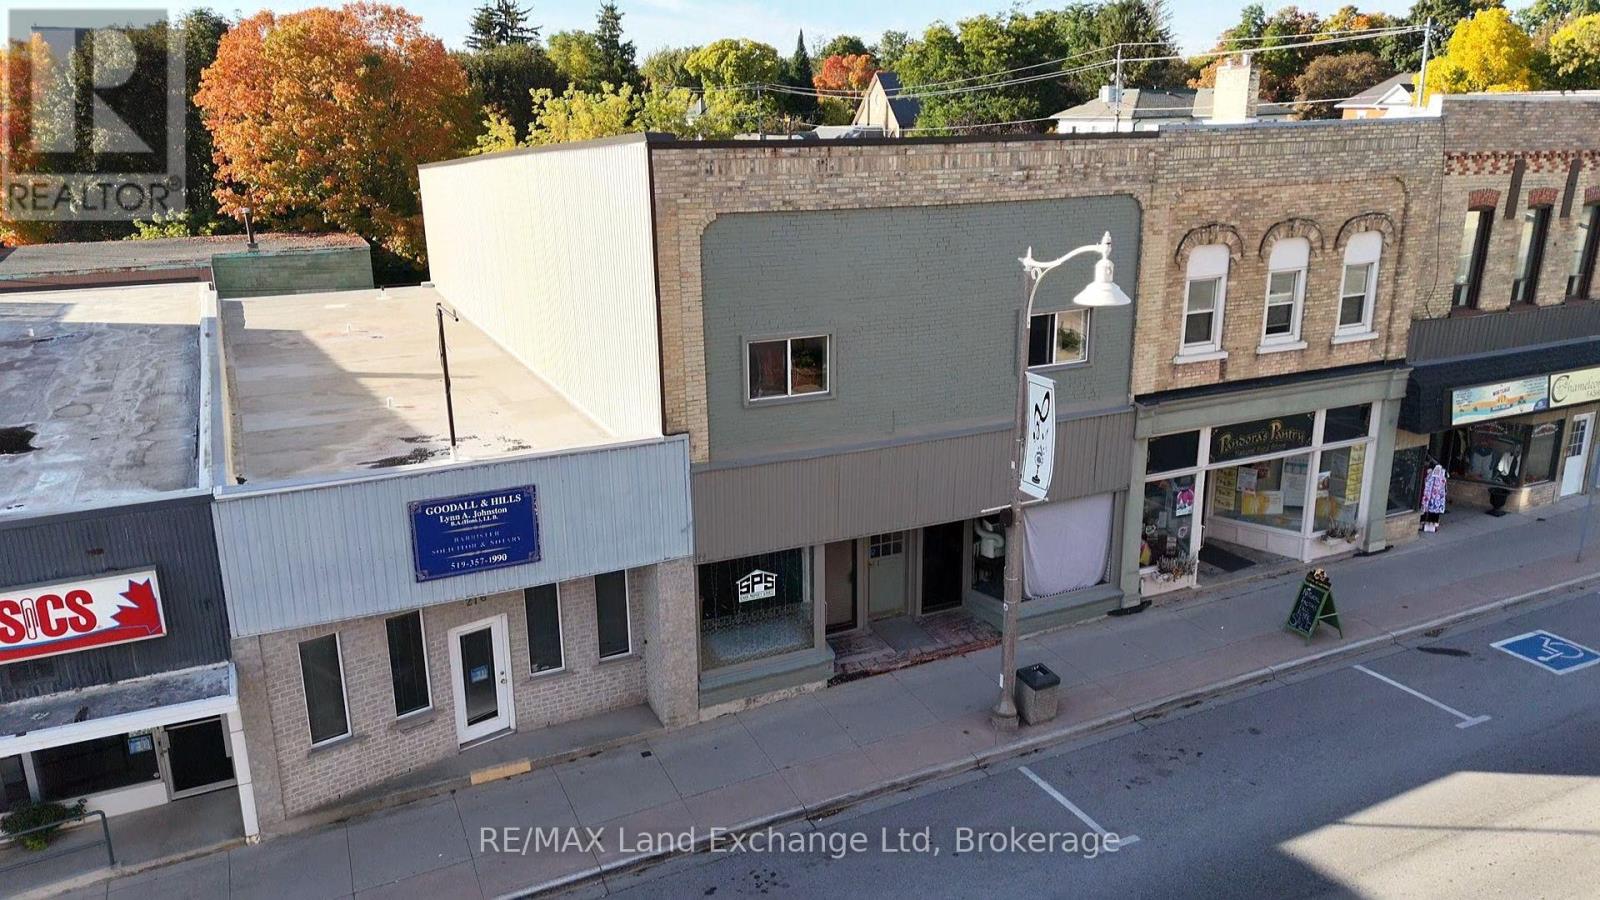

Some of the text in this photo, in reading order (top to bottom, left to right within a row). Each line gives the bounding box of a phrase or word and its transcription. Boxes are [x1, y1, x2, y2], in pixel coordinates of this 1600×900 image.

[425, 494, 522, 515] GOODALL & HILLS
[440, 514, 460, 524] Lynn
[472, 507, 508, 518] Johnston
[432, 543, 477, 554] SOLICITOR
[490, 536, 521, 545] NOTARY
[454, 531, 500, 543] BARRISTER
[450, 553, 508, 569] 519-357-1990
[739, 573, 774, 594] SPS
